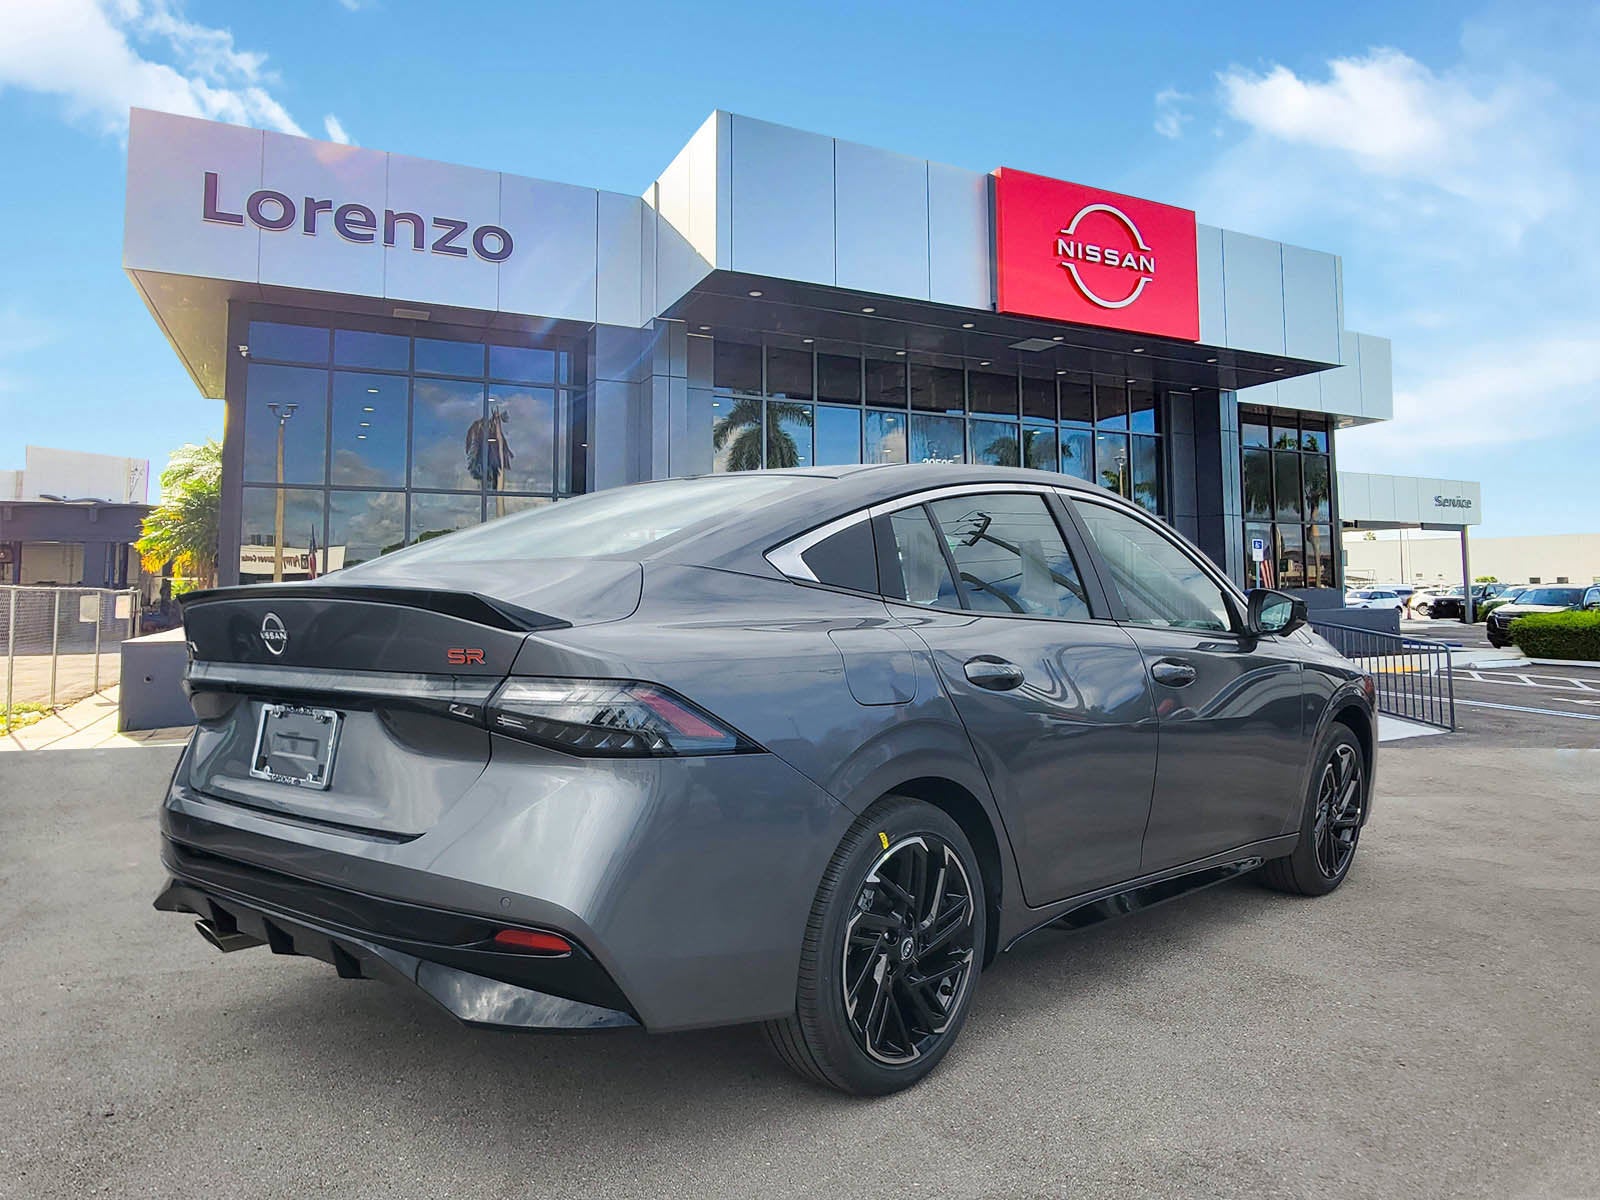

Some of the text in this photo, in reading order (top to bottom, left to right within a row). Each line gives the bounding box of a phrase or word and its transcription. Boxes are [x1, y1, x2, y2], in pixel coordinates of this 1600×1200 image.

[203, 171, 514, 262] Lorenzo
[1057, 238, 1155, 273] NISSAN
[1433, 495, 1472, 509] Service
[447, 648, 487, 665] SR
